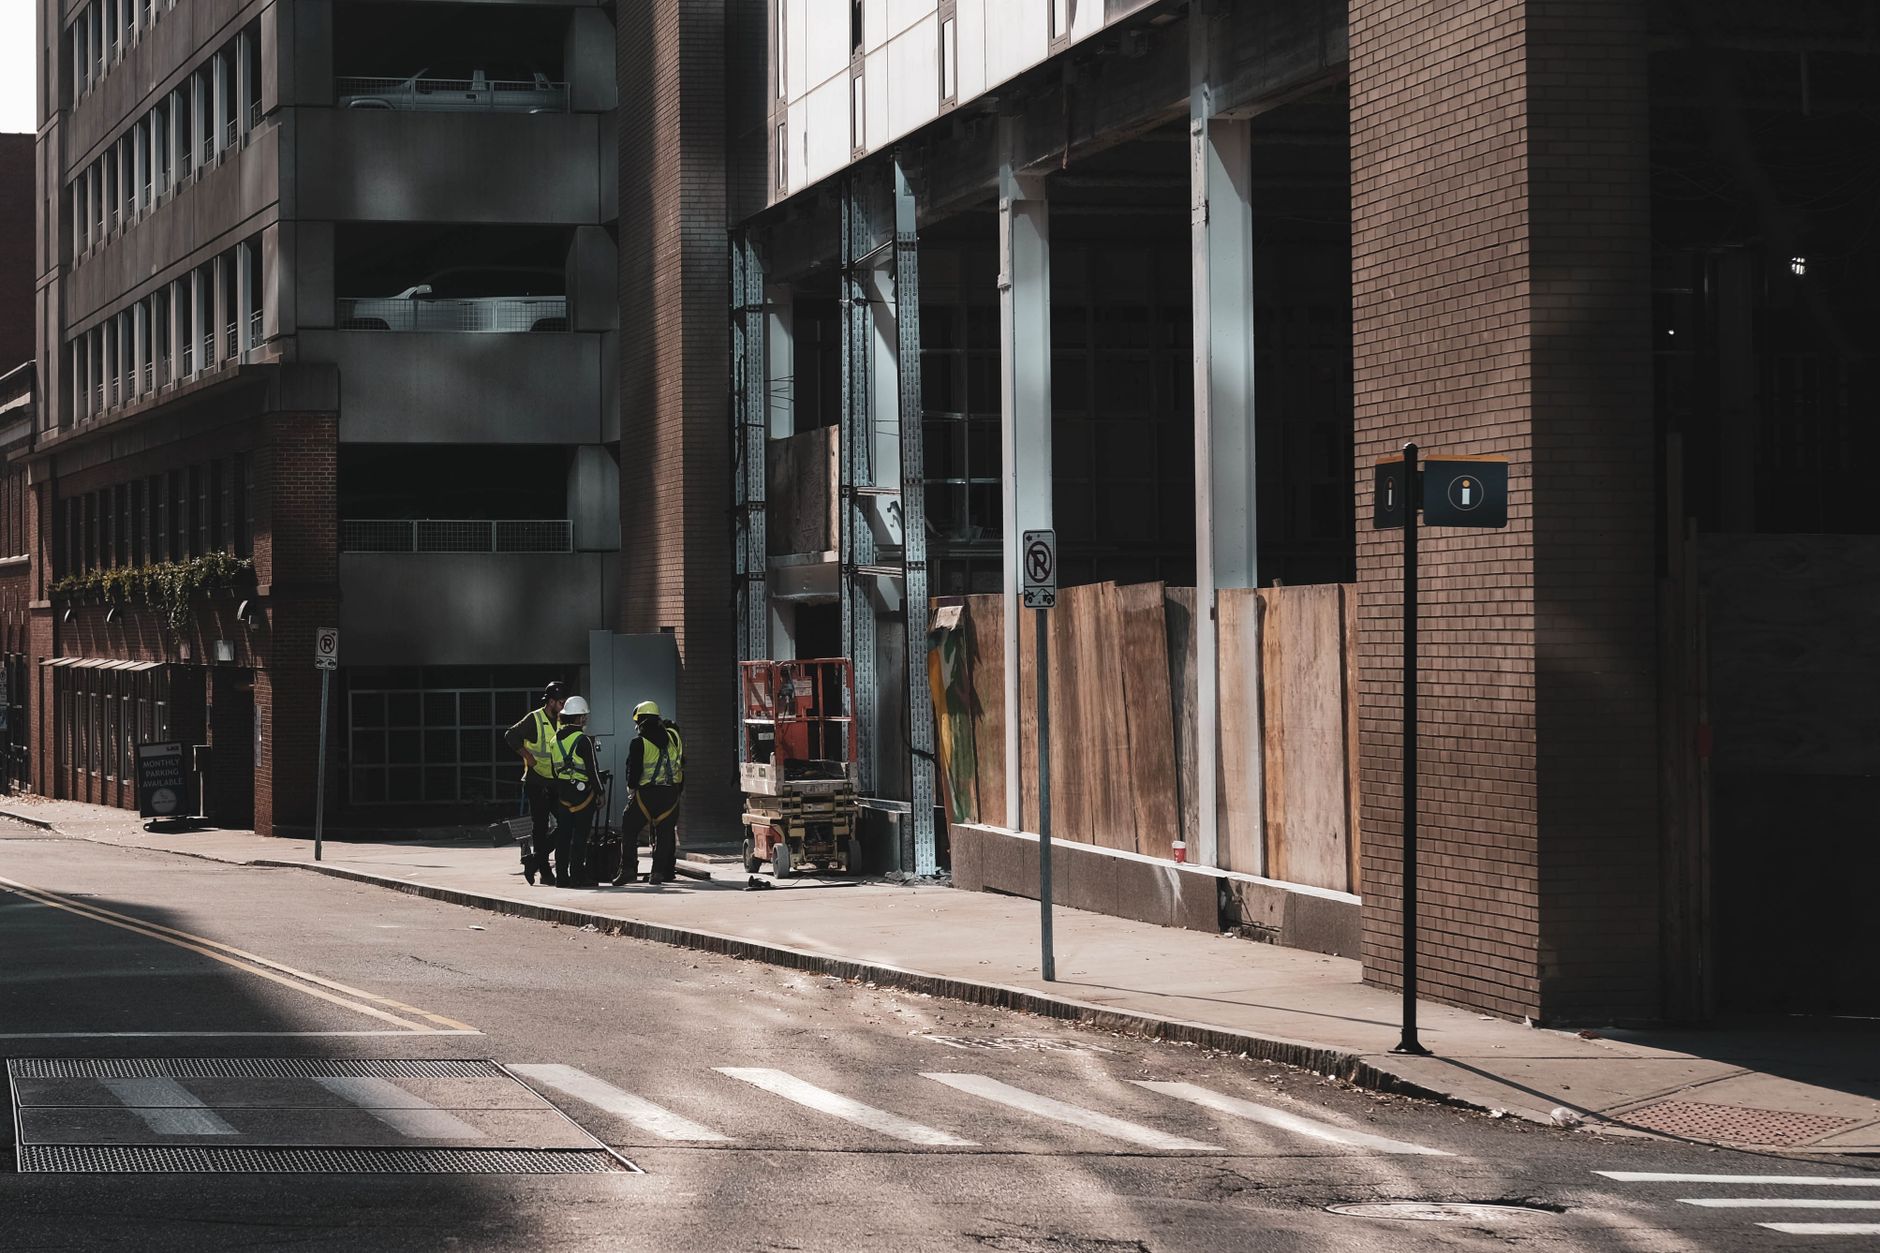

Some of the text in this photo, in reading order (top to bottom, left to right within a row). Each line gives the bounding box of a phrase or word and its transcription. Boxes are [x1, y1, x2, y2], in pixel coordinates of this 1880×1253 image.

[143, 758, 180, 768] MONTHLY
[145, 768, 179, 777] PARKING
[143, 778, 184, 788] AVAILABLE
